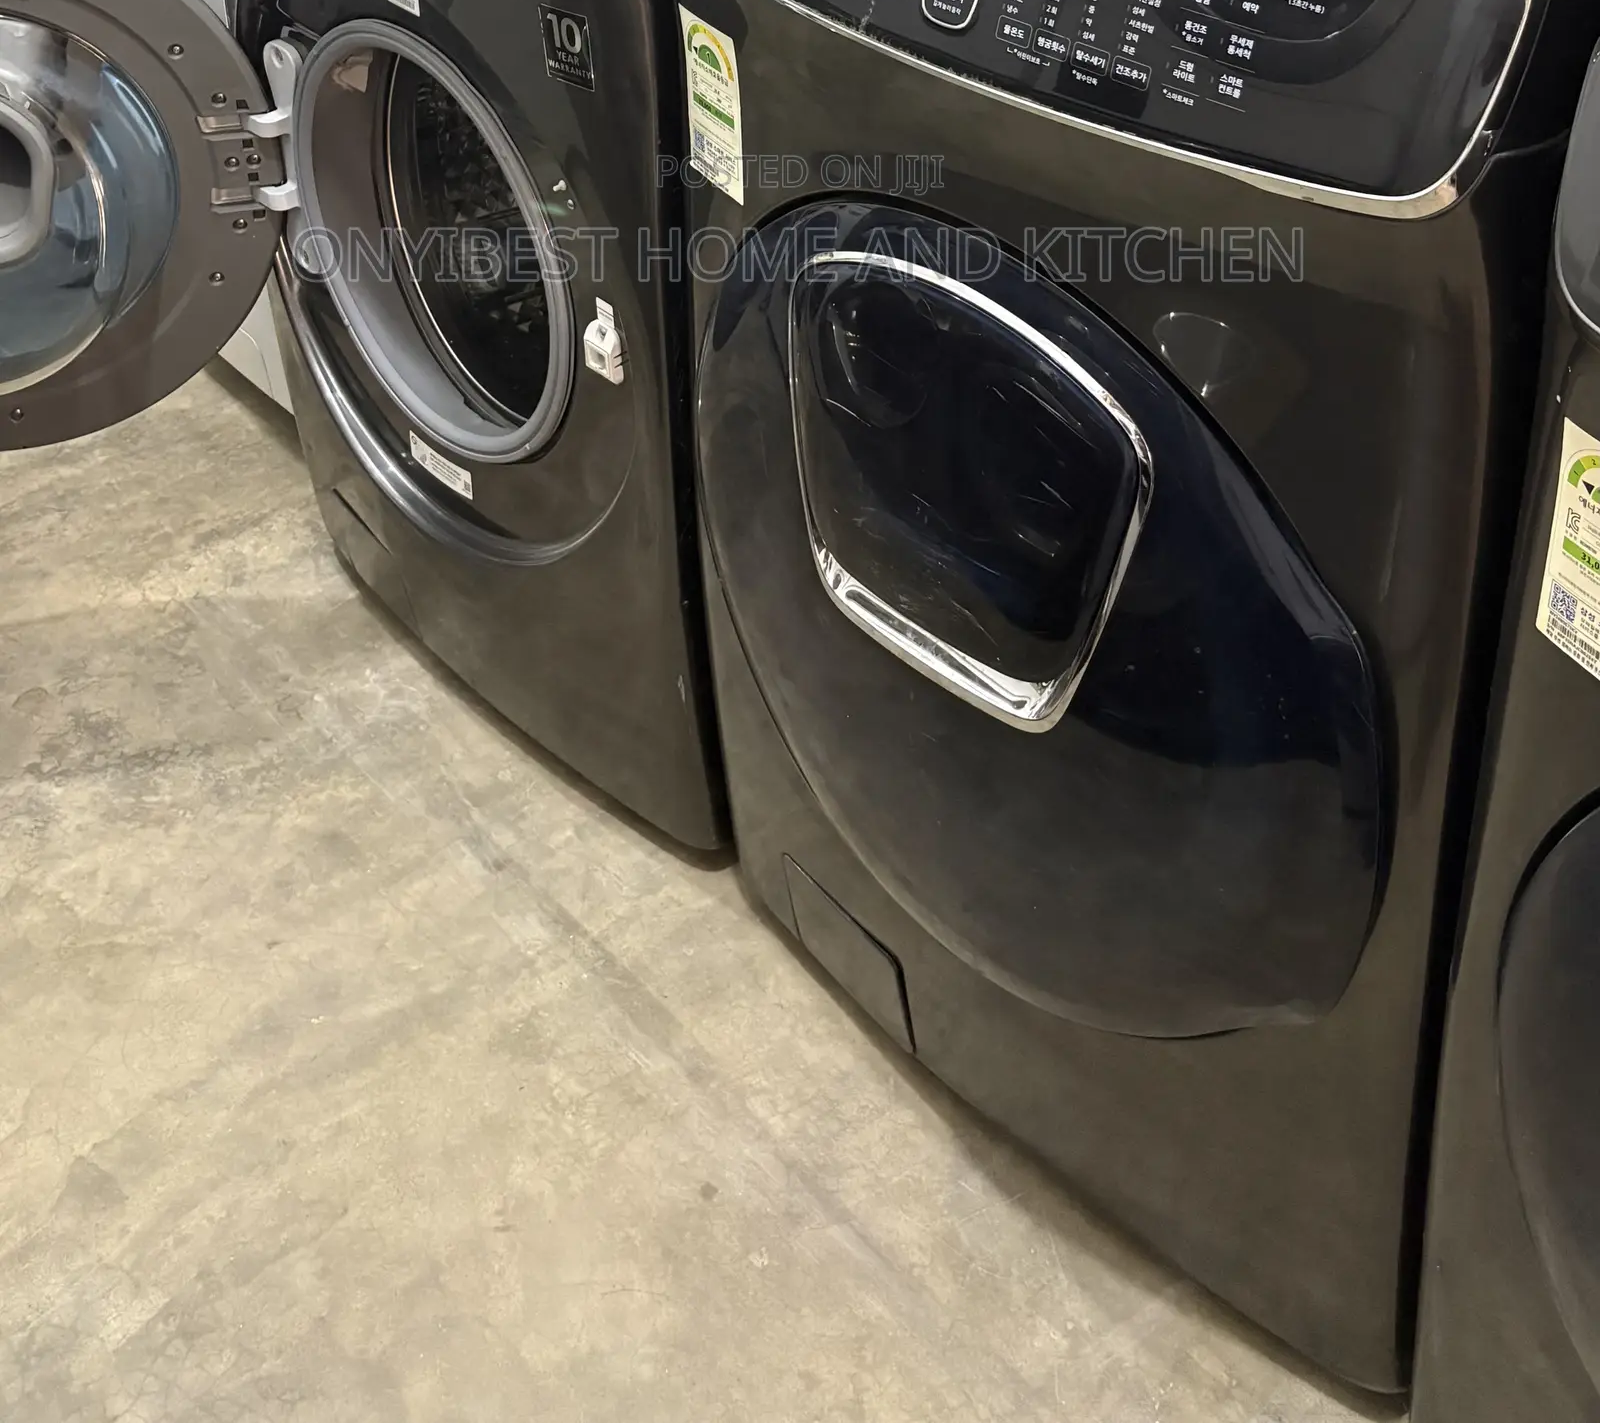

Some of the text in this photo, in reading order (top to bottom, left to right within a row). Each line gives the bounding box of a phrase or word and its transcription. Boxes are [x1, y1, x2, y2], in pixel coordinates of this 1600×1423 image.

[547, 13, 581, 54] 10
[556, 50, 580, 66] YEAR
[1075, 49, 1106, 68] 탈수세기
[548, 59, 591, 79] WARRANTY
[1116, 64, 1147, 83] 건조추가
